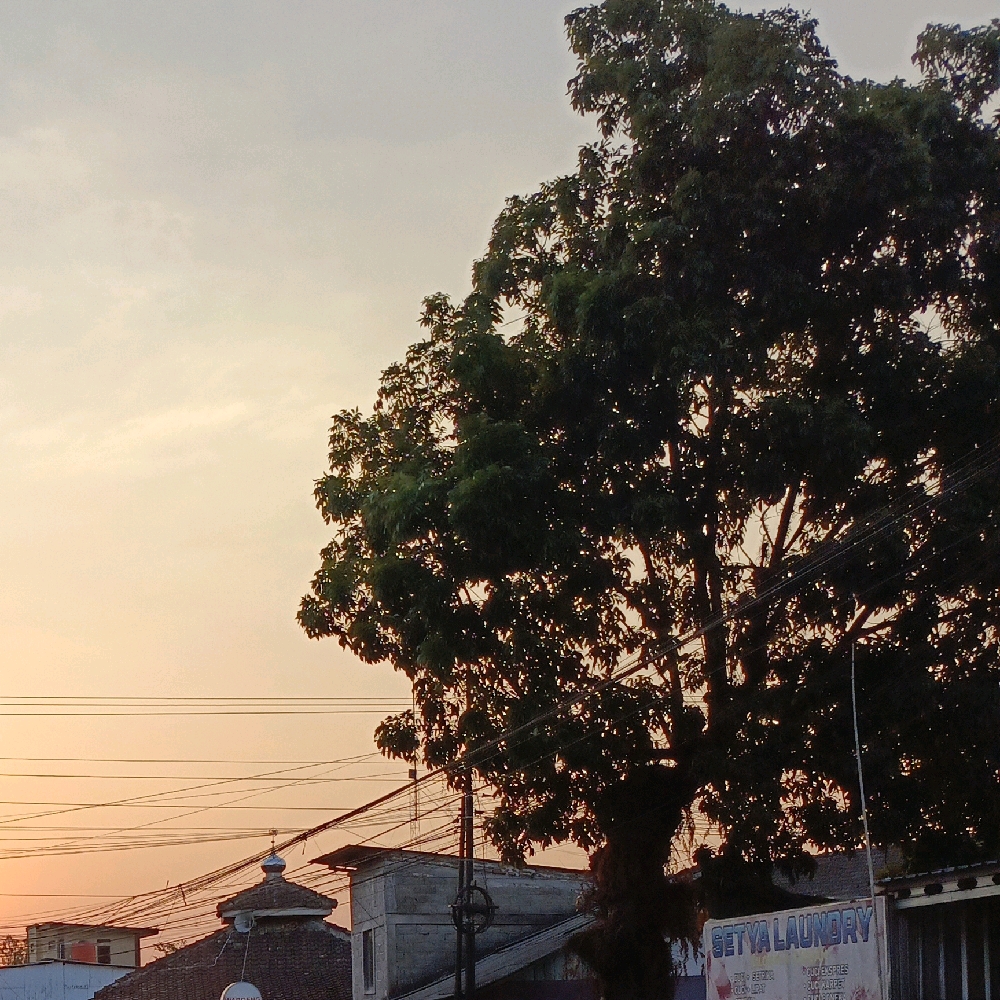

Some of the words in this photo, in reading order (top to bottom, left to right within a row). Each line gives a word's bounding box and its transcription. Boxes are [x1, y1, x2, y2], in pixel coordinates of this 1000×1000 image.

[711, 919, 771, 959] SETYA
[773, 905, 873, 952] LAUNDRY
[821, 964, 848, 976] EKSPRES
